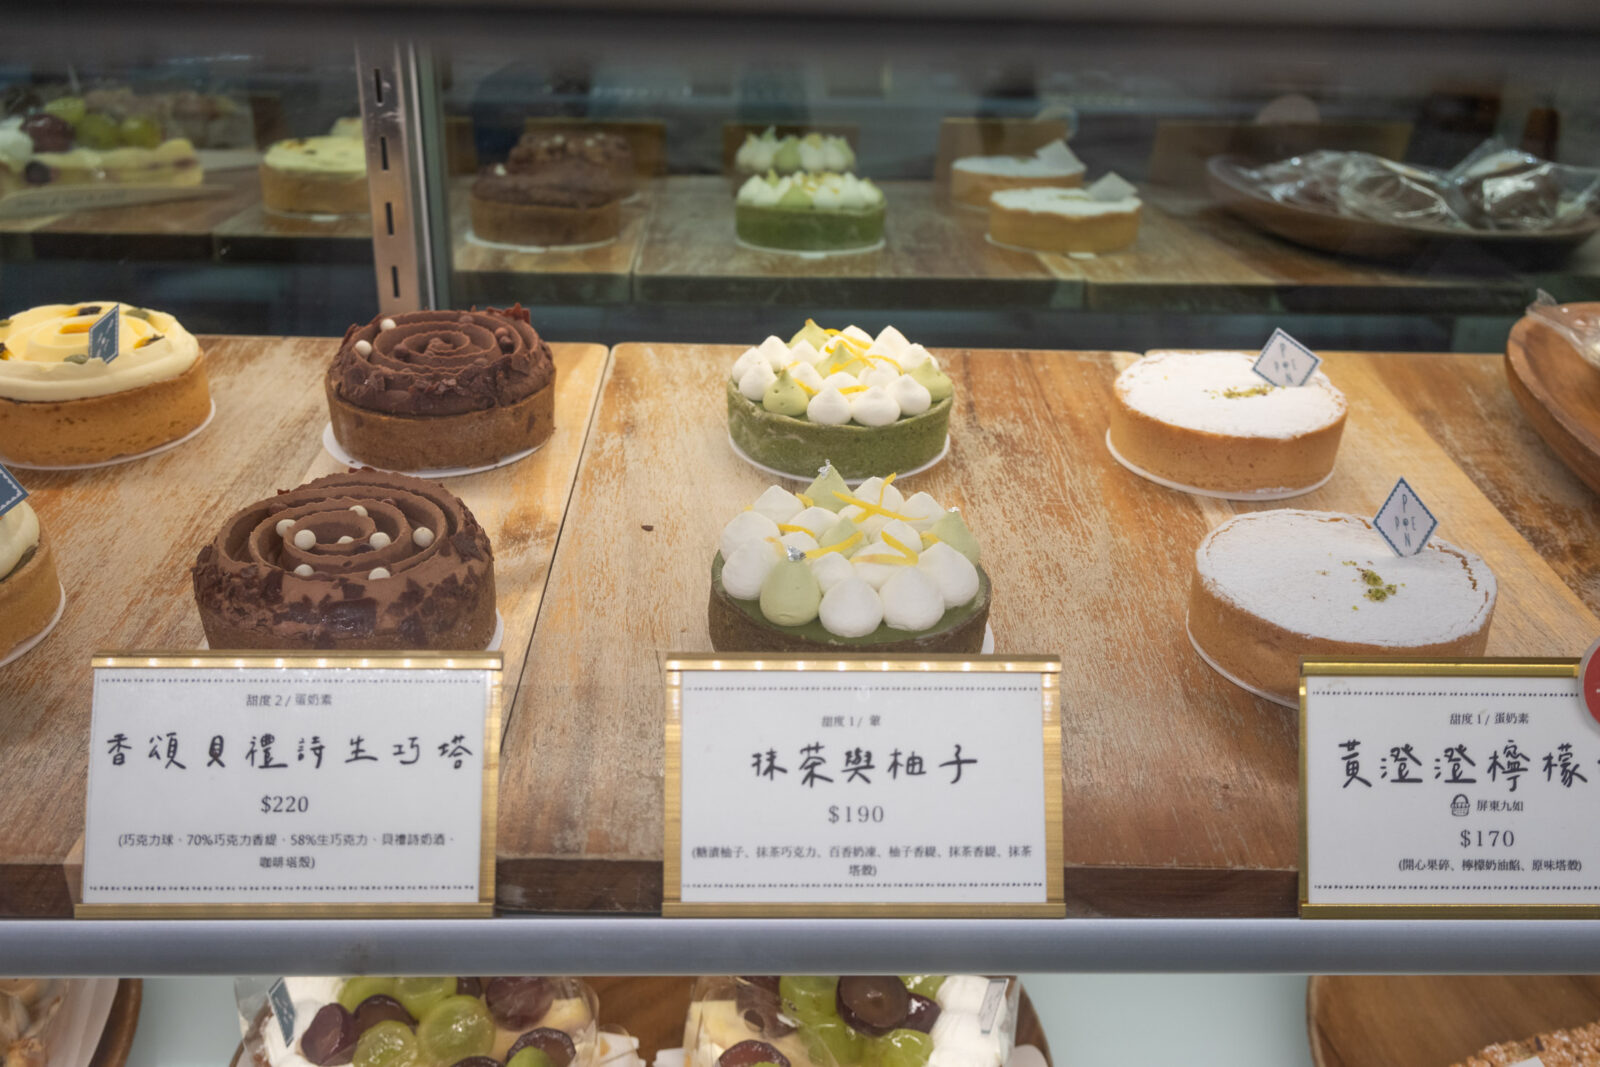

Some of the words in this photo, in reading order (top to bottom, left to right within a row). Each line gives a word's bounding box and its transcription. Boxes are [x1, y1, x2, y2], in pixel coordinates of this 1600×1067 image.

[1449, 712, 1474, 726] 甜度
[1494, 711, 1530, 725] 蛋奶素
[106, 732, 474, 770] 香頌貝禮詩生巧塔
[750, 741, 979, 789] 抹茶與柚子
[1337, 739, 1600, 792] 黃澄澄檸檬
[260, 795, 310, 815] $220
[827, 804, 885, 825] $190
[1476, 799, 1524, 813] 屏東九如
[1459, 829, 1515, 849] $170
